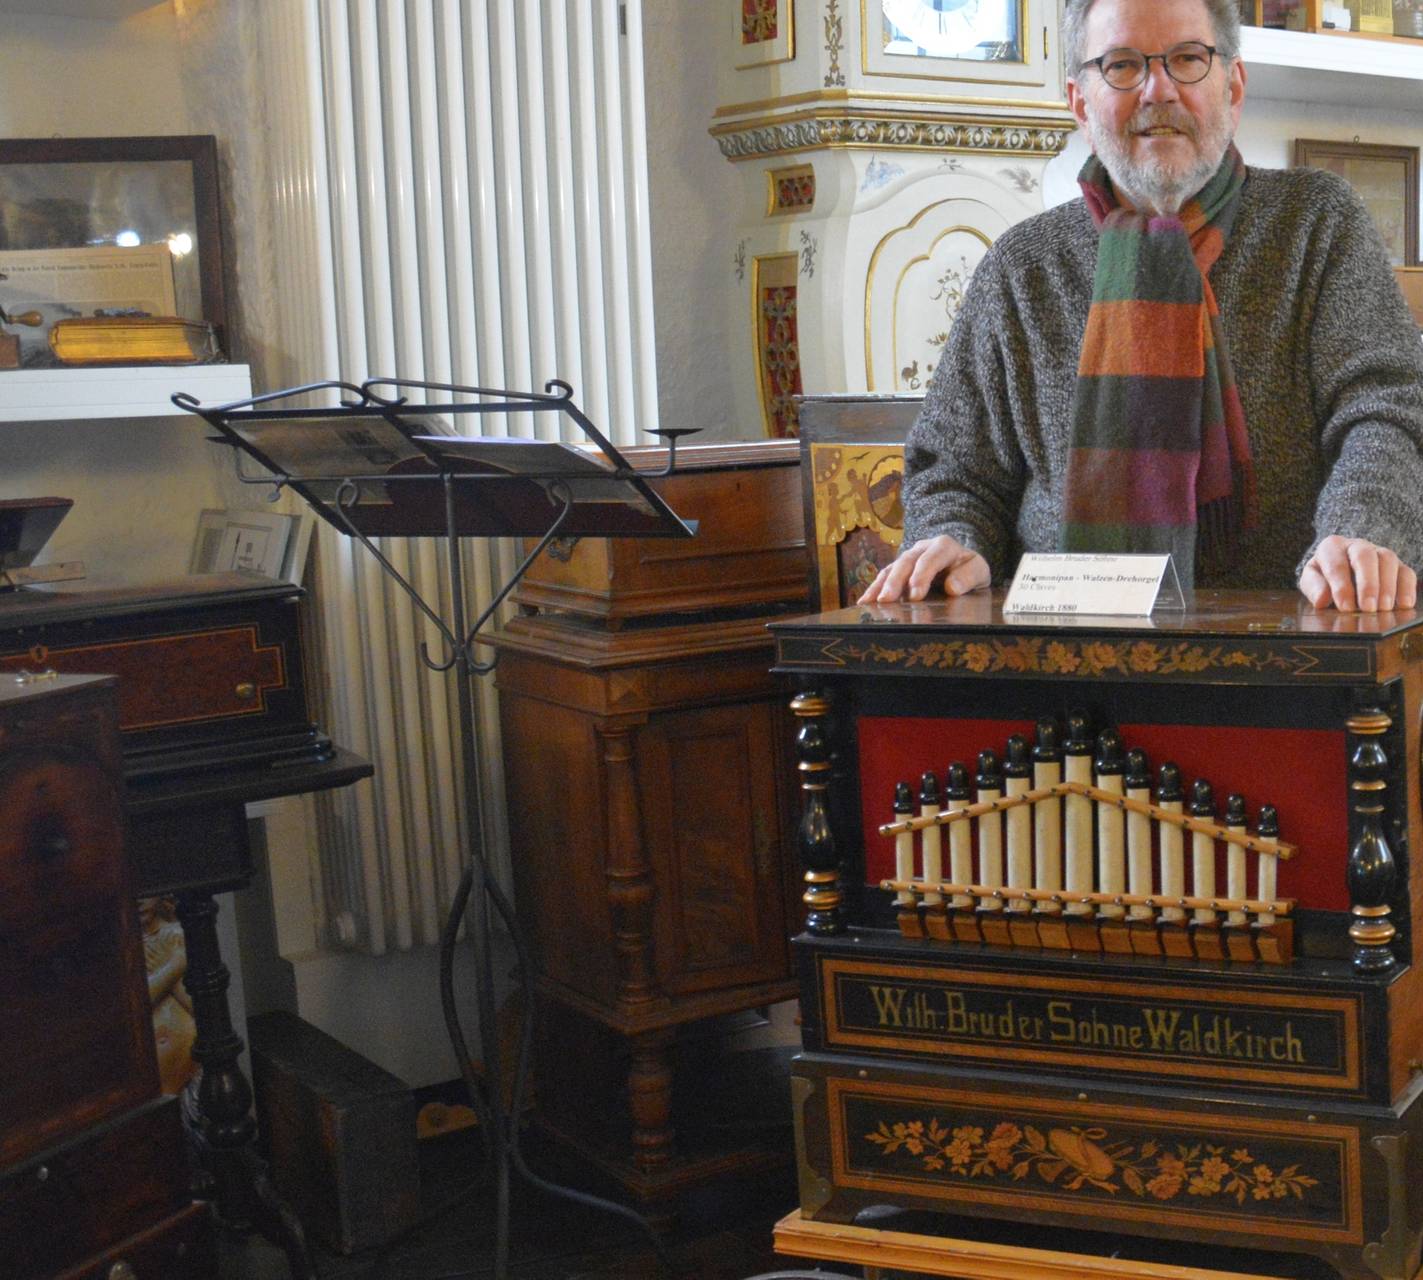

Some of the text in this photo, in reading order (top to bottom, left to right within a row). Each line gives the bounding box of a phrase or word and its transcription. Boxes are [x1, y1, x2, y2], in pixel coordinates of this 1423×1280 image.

[1012, 603, 1055, 612] Waldkirch
[944, 990, 1044, 1040] Bruder
[1141, 1007, 1305, 1063] Waldkirch
